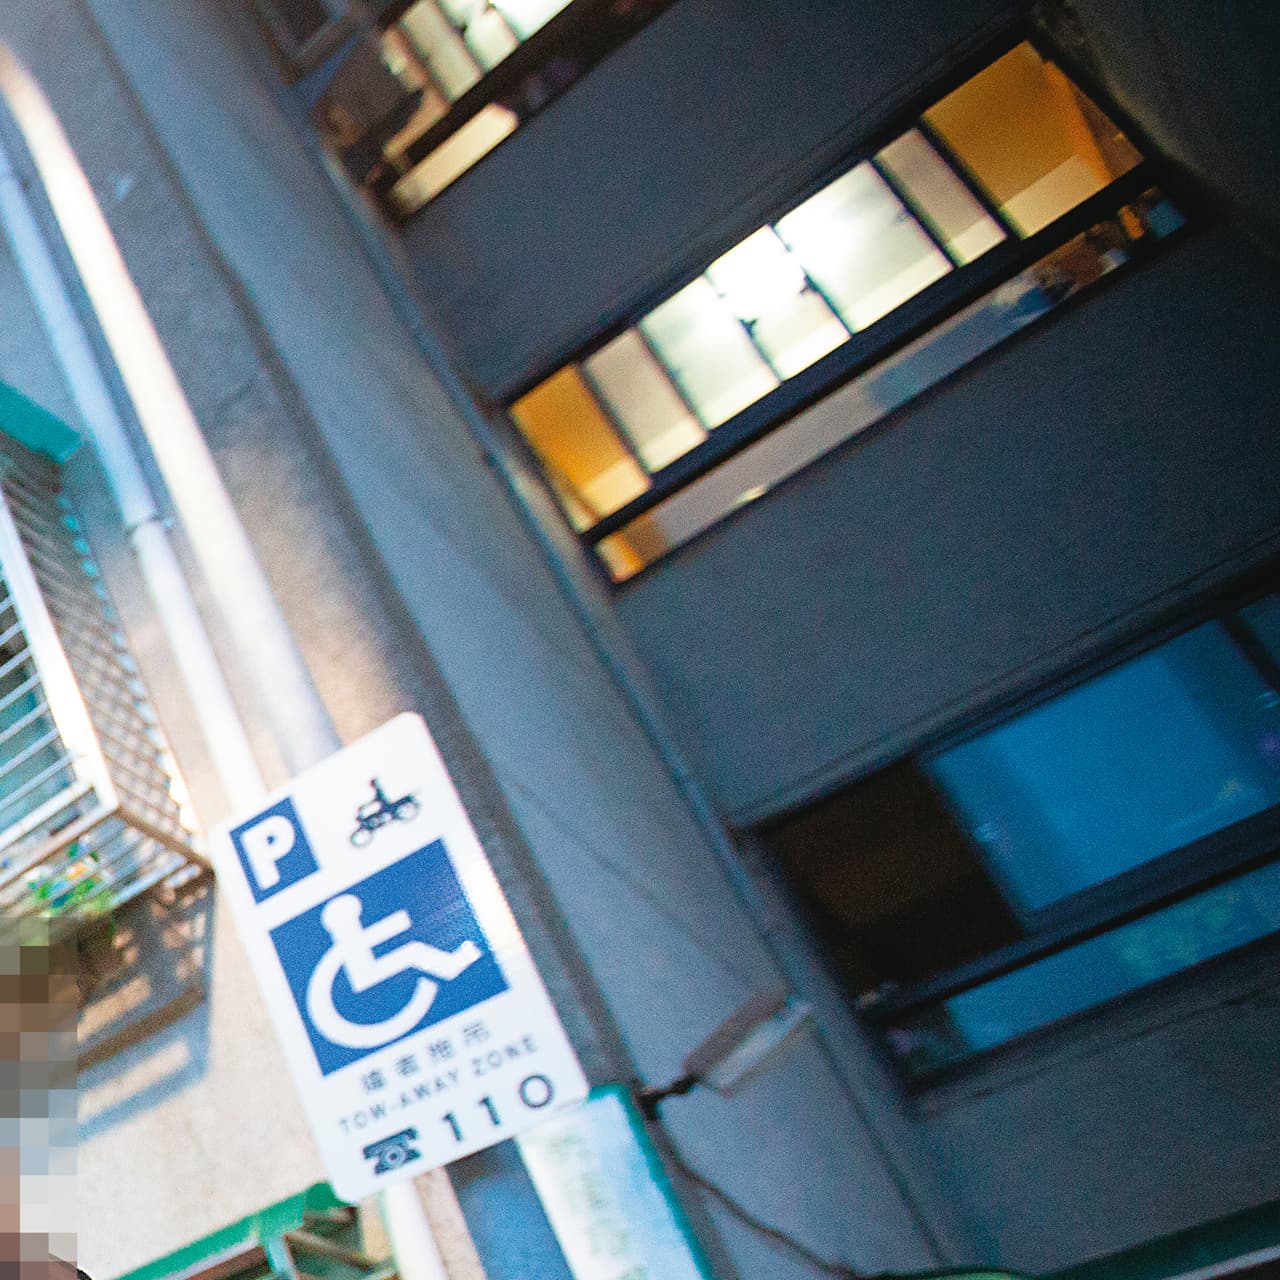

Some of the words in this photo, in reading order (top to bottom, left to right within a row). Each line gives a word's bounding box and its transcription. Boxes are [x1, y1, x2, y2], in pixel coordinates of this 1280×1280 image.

[239, 815, 297, 892] P
[339, 1069, 459, 1134] TOW-AWAY
[471, 1034, 538, 1077] ZONE
[442, 1074, 554, 1142] 110
